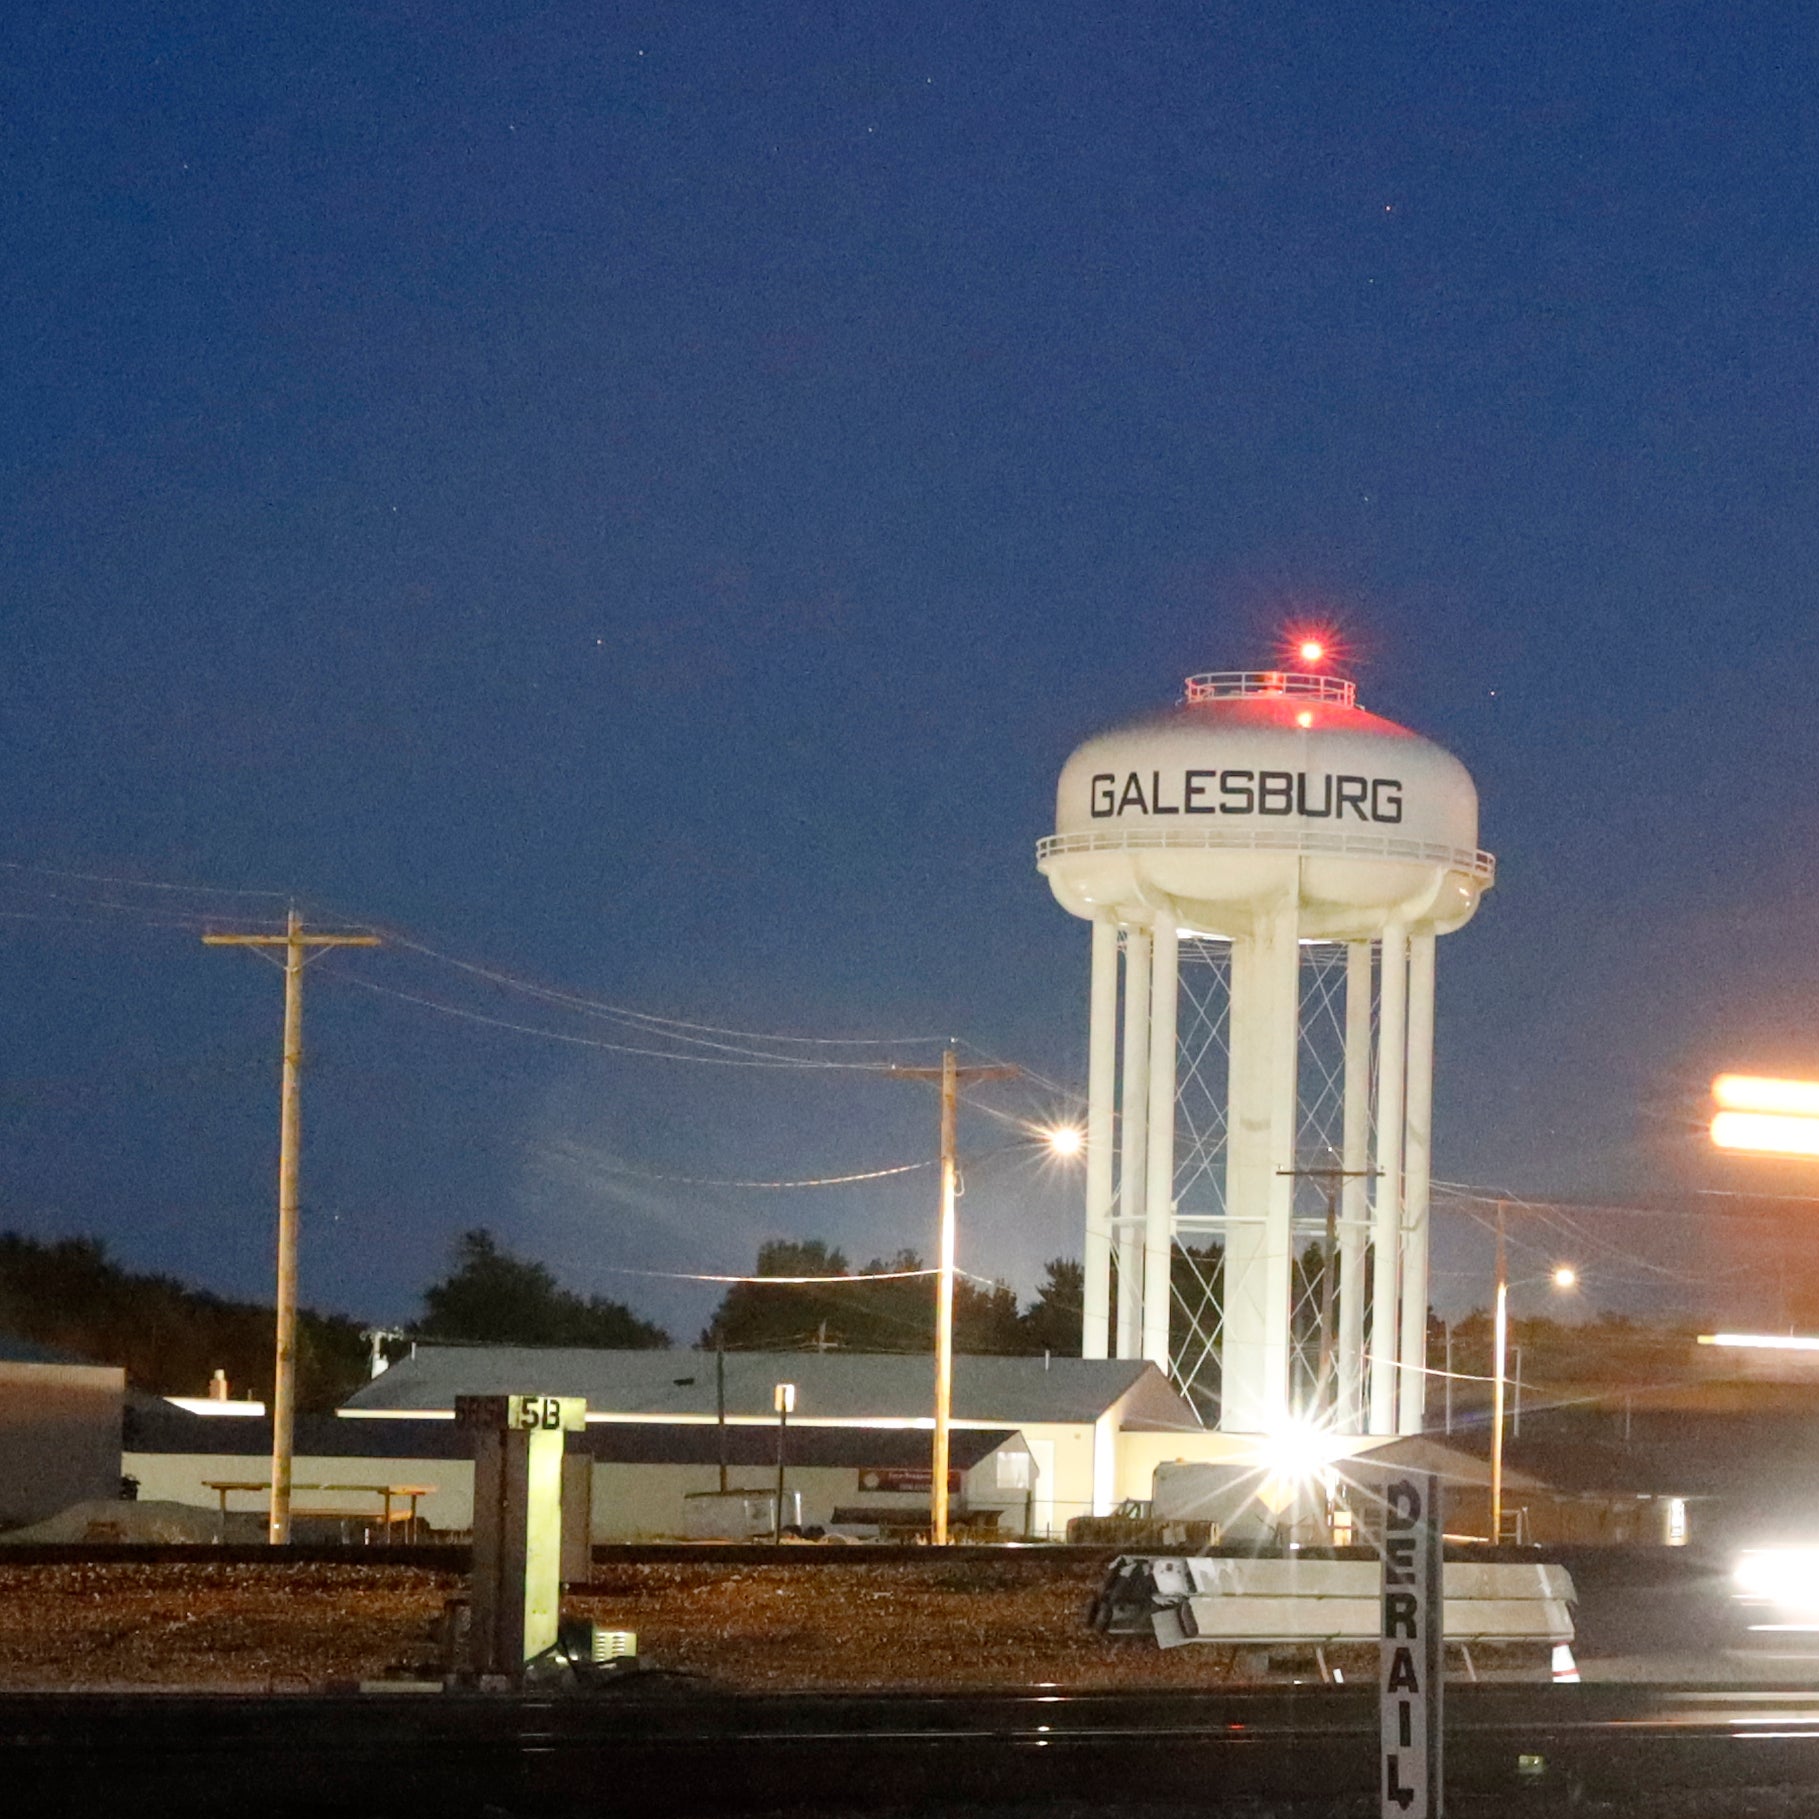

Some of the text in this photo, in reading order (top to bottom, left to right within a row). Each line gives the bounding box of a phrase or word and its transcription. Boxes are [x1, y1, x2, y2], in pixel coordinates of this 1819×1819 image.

[1090, 770, 1403, 824] GALESBURG
[520, 1396, 561, 1431] 5B
[1384, 1480, 1422, 1804] DERAIL
